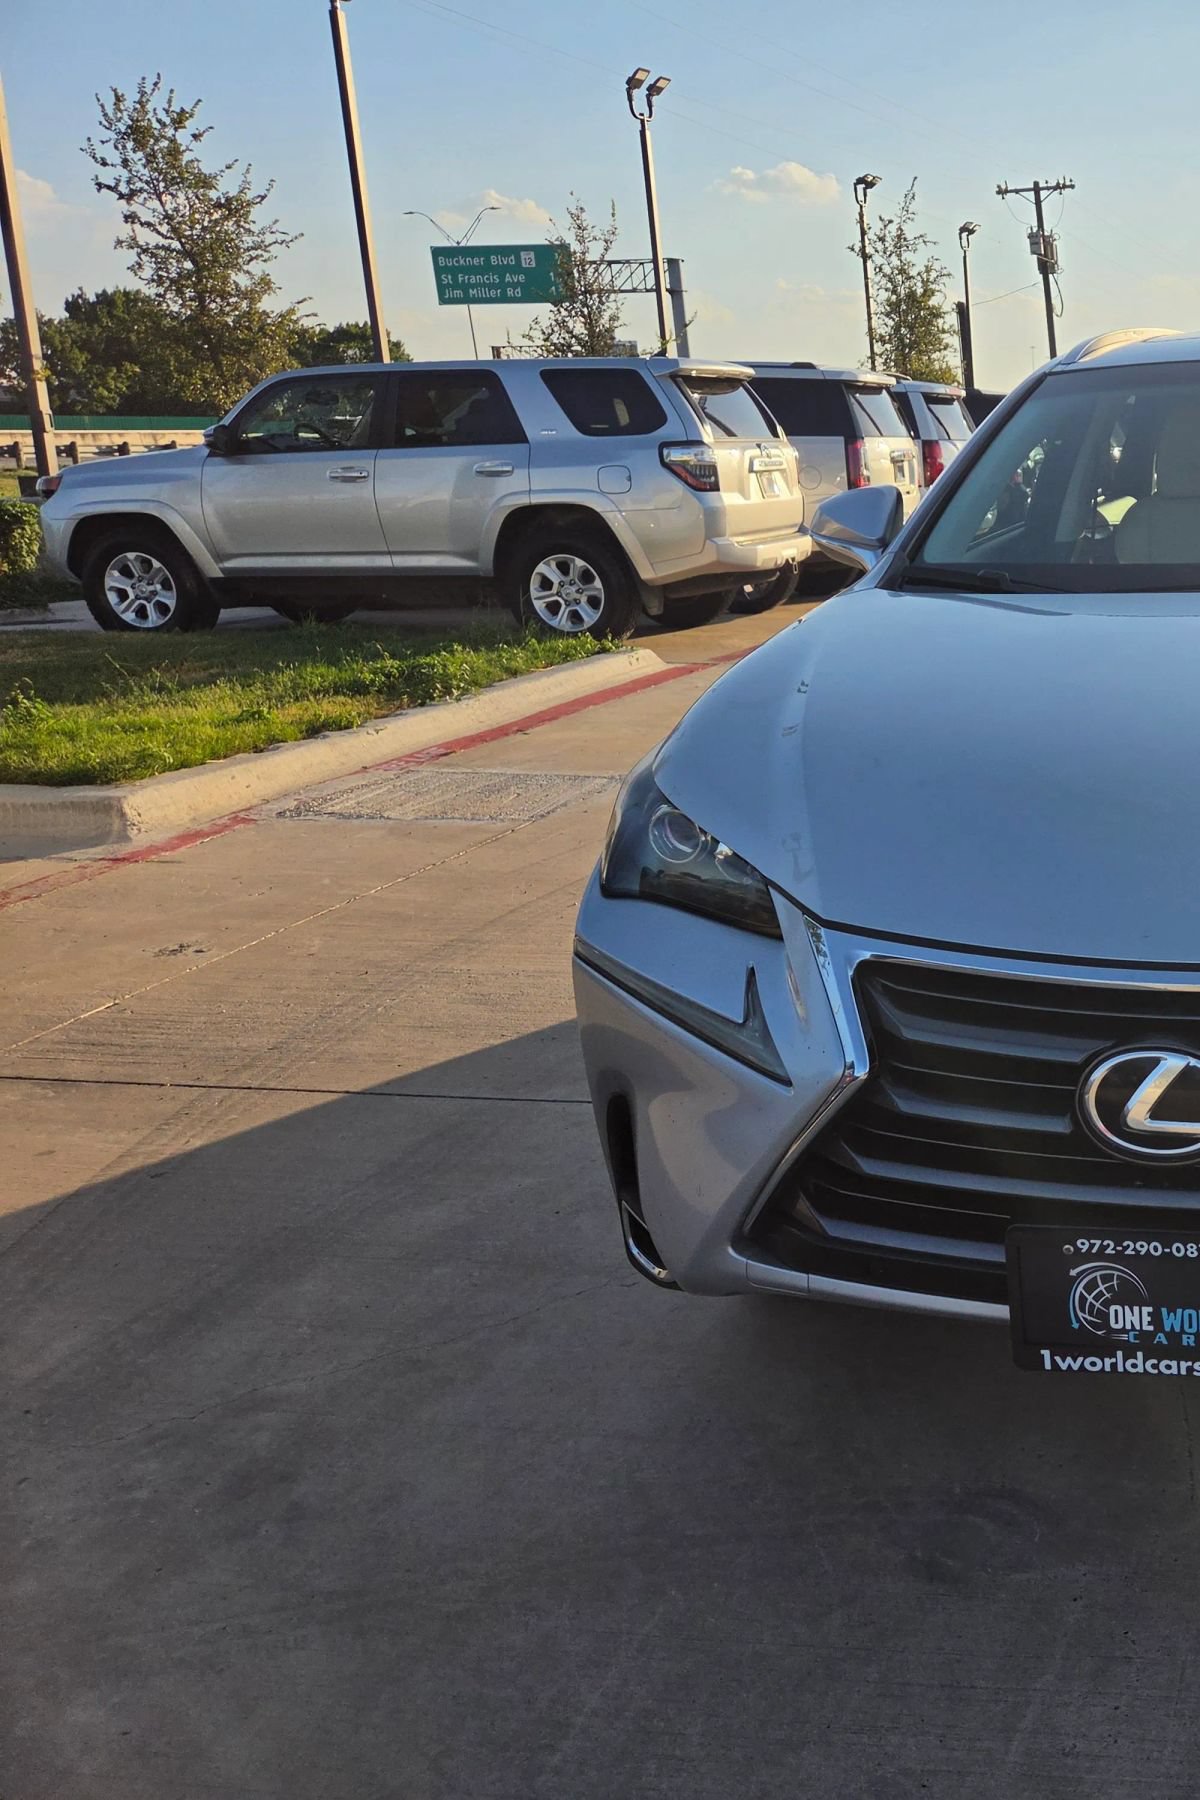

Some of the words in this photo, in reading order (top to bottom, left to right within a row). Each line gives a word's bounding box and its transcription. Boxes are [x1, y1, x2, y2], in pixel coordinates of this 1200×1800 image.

[438, 256, 485, 266] Buckner
[490, 255, 515, 265] Blvd
[524, 257, 533, 266] 12
[441, 274, 453, 284] St
[458, 273, 500, 283] Francis
[505, 273, 526, 283] Ave
[444, 288, 464, 298] Jim
[469, 287, 501, 298] Miller
[506, 287, 522, 297] Rd
[1109, 1304, 1154, 1332] ONE
